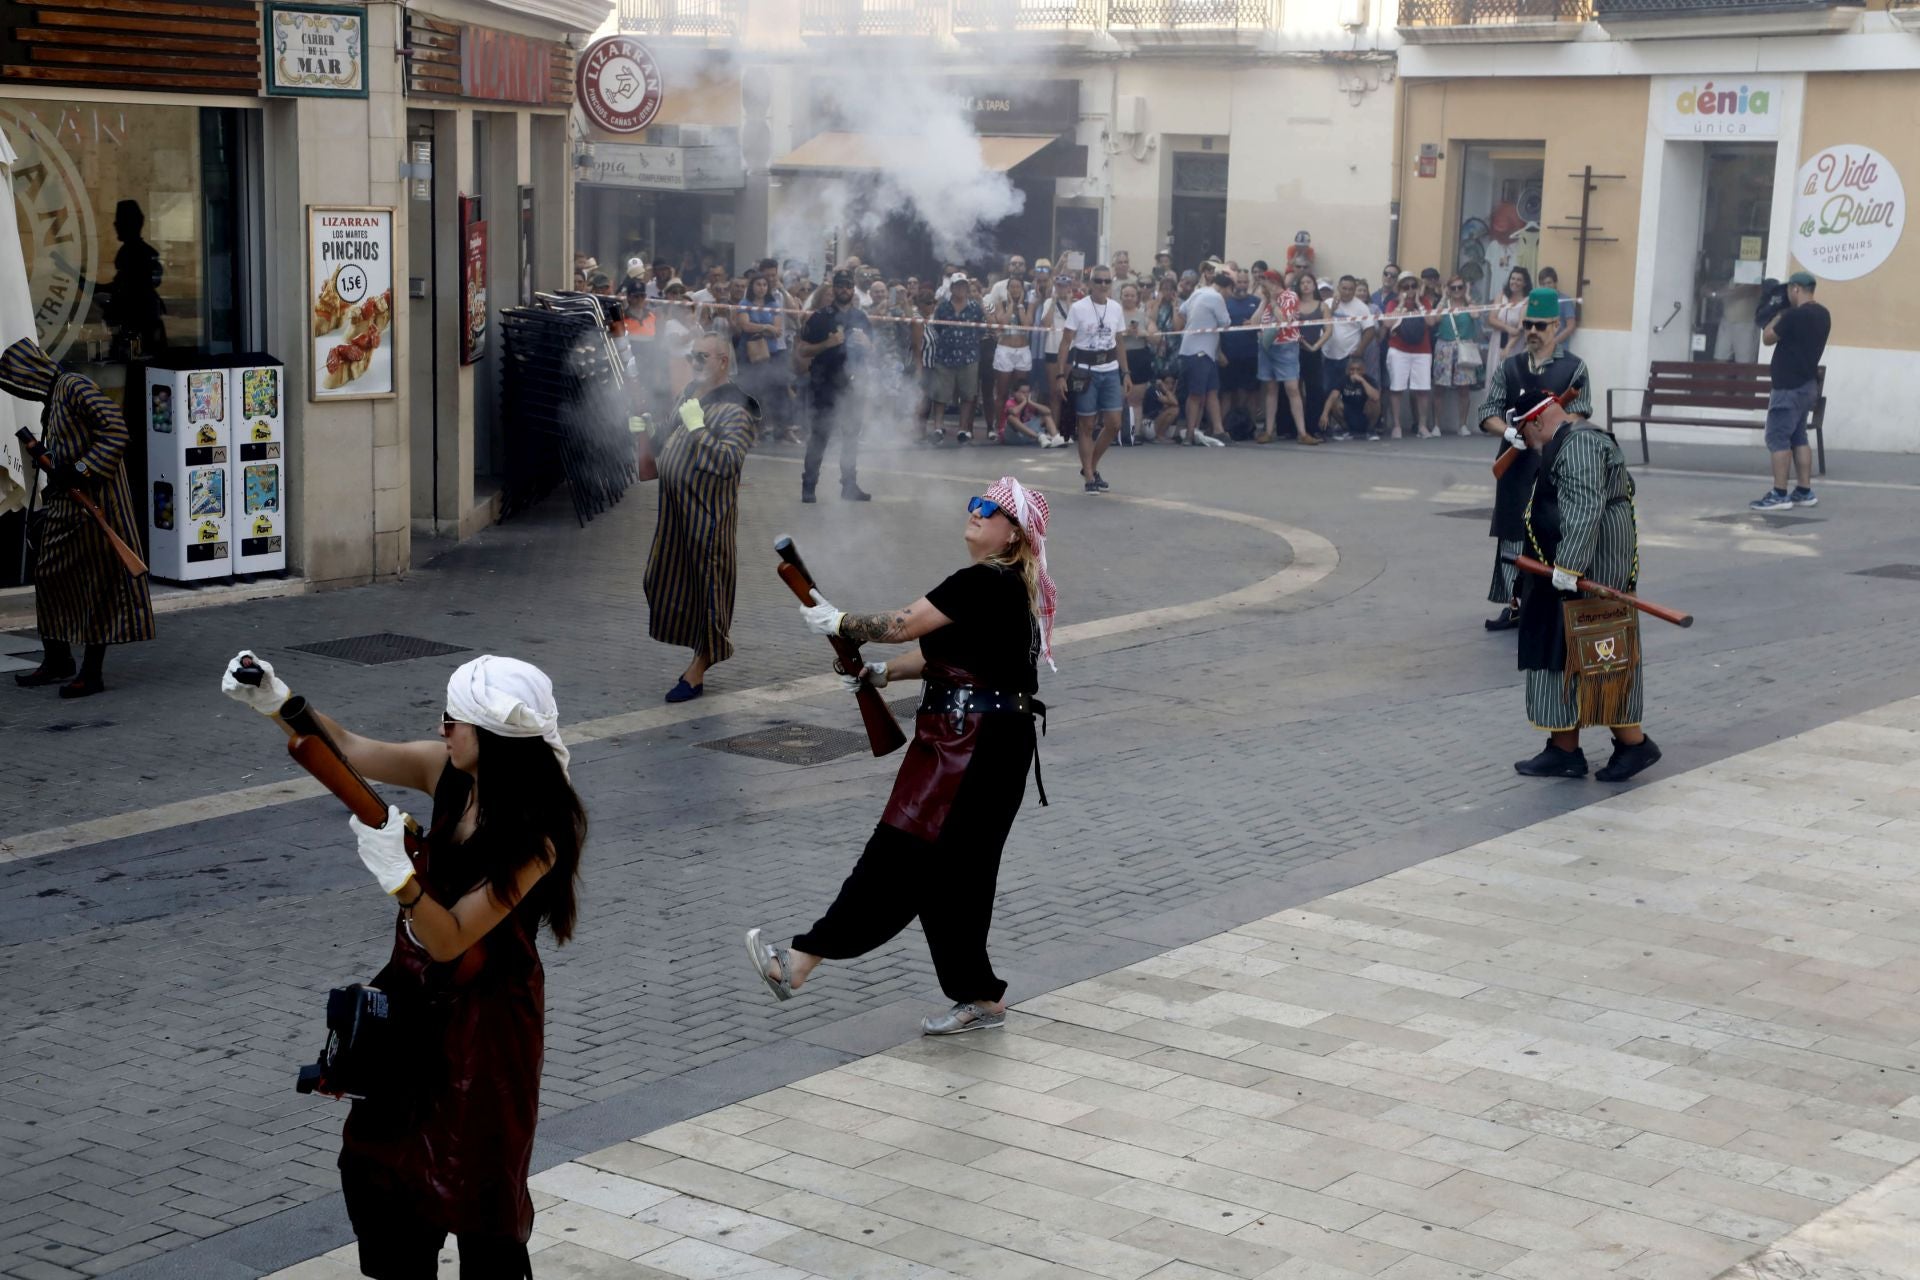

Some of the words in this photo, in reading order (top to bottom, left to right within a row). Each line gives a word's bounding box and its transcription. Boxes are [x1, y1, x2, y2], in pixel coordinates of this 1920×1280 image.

[301, 33, 335, 46] CARRER
[308, 46, 317, 55] DE
[319, 48, 328, 56] LA
[297, 57, 341, 74] MAR
[588, 43, 659, 91] LIZARRAN
[986, 100, 1010, 112] TAPAS
[1676, 81, 1770, 115] dénia
[1694, 120, 1747, 134] única
[638, 173, 683, 185] COMPLEMENTOS
[1817, 152, 1879, 192] Vida
[322, 216, 379, 227] LIZARRAN
[1799, 214, 1816, 237] de
[1818, 194, 1895, 235] Brian
[332, 230, 344, 239] LOS
[345, 230, 368, 239] MARTES
[322, 240, 380, 261] PINCHOS
[1812, 239, 1873, 256] SOUVENIRS
[341, 275, 362, 292] 1,5€
